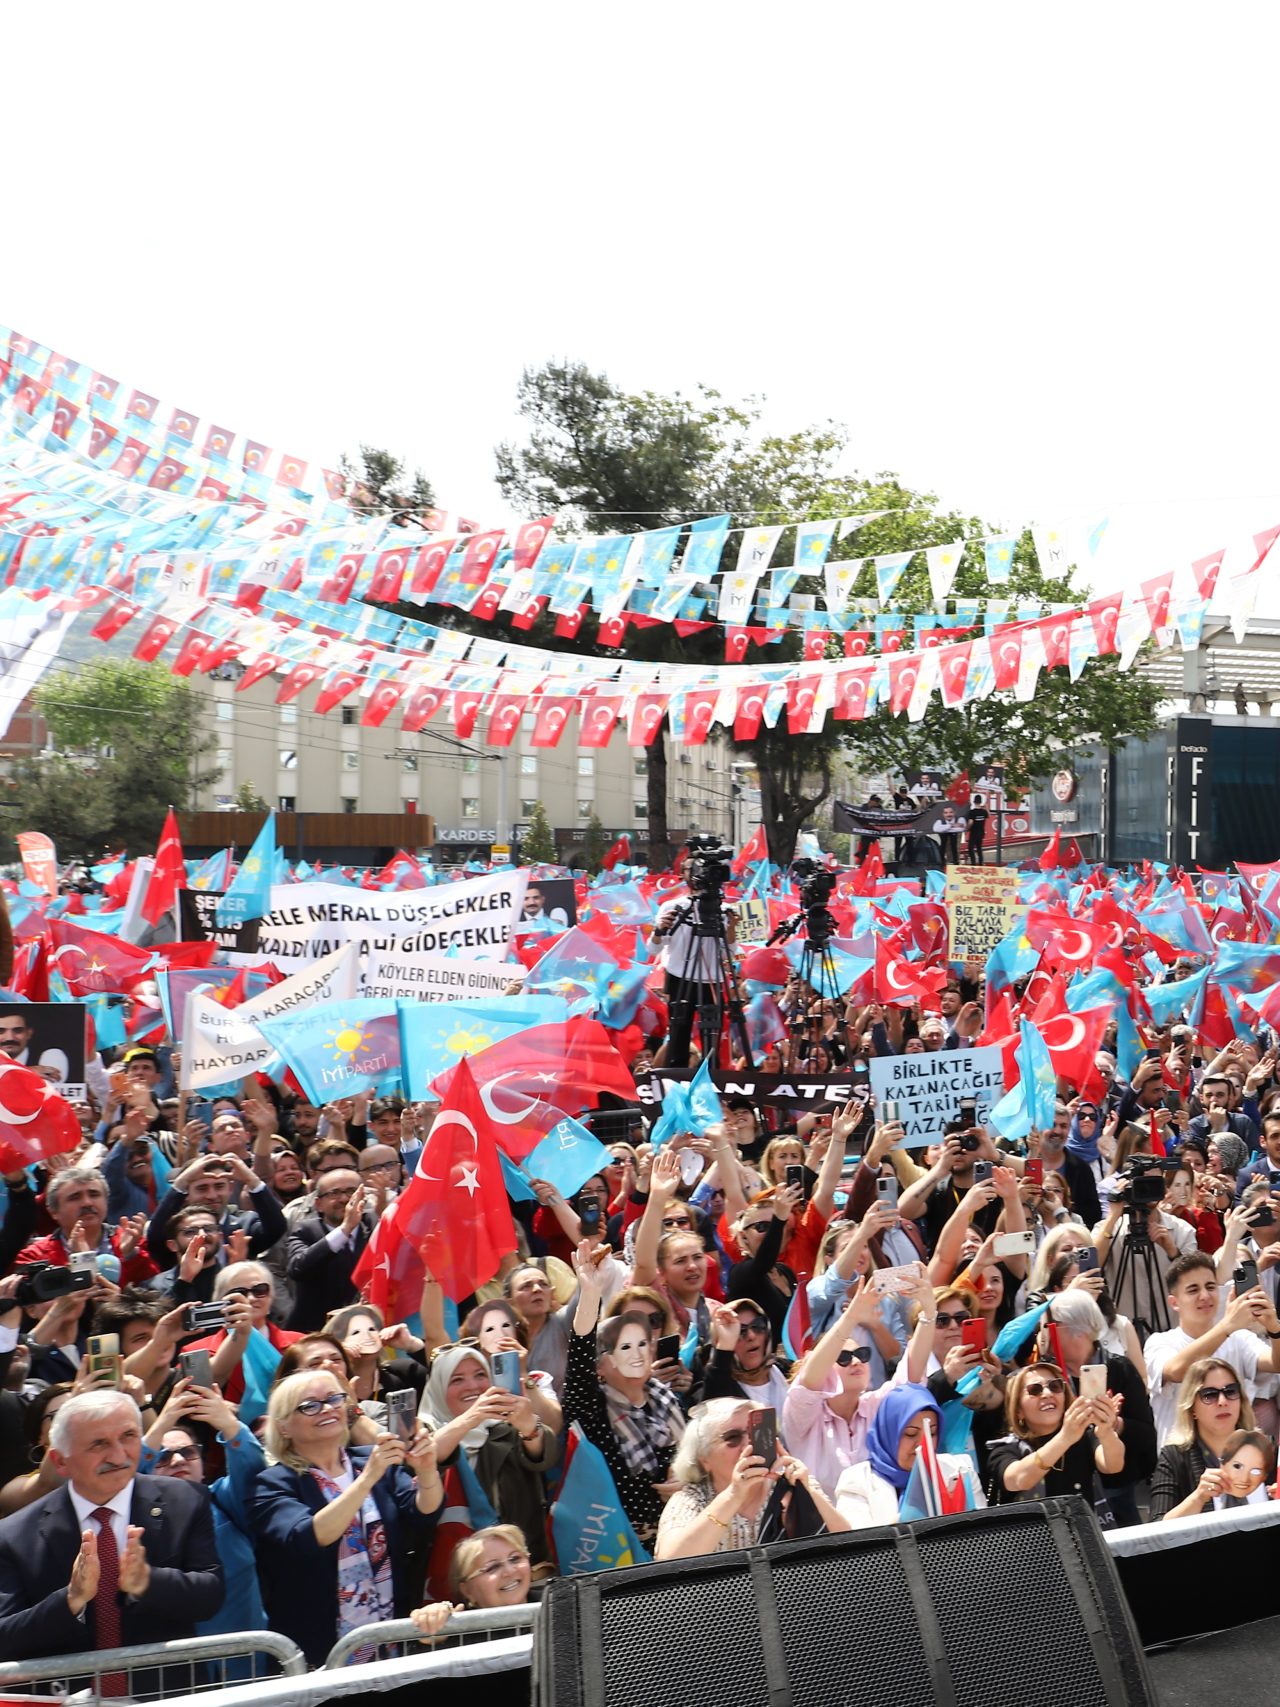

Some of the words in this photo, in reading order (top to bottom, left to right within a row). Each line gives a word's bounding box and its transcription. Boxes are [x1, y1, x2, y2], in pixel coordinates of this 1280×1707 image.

[438, 828, 496, 845] KARDEŞ
[194, 894, 247, 912] ŞEKER
[308, 903, 381, 922] MERAL
[386, 892, 512, 926] DÜŞECEKLER
[198, 913, 213, 928] %
[216, 914, 244, 930] 115
[204, 931, 238, 948] ZAM
[257, 936, 308, 958] KALDI
[401, 925, 512, 953] GİDECEKLE
[378, 962, 425, 983] KÖYLER
[427, 968, 465, 987] ELDEN
[893, 1058, 973, 1080] BİRLİKTE
[885, 1070, 1004, 1101] KAZANACAĞIZ
